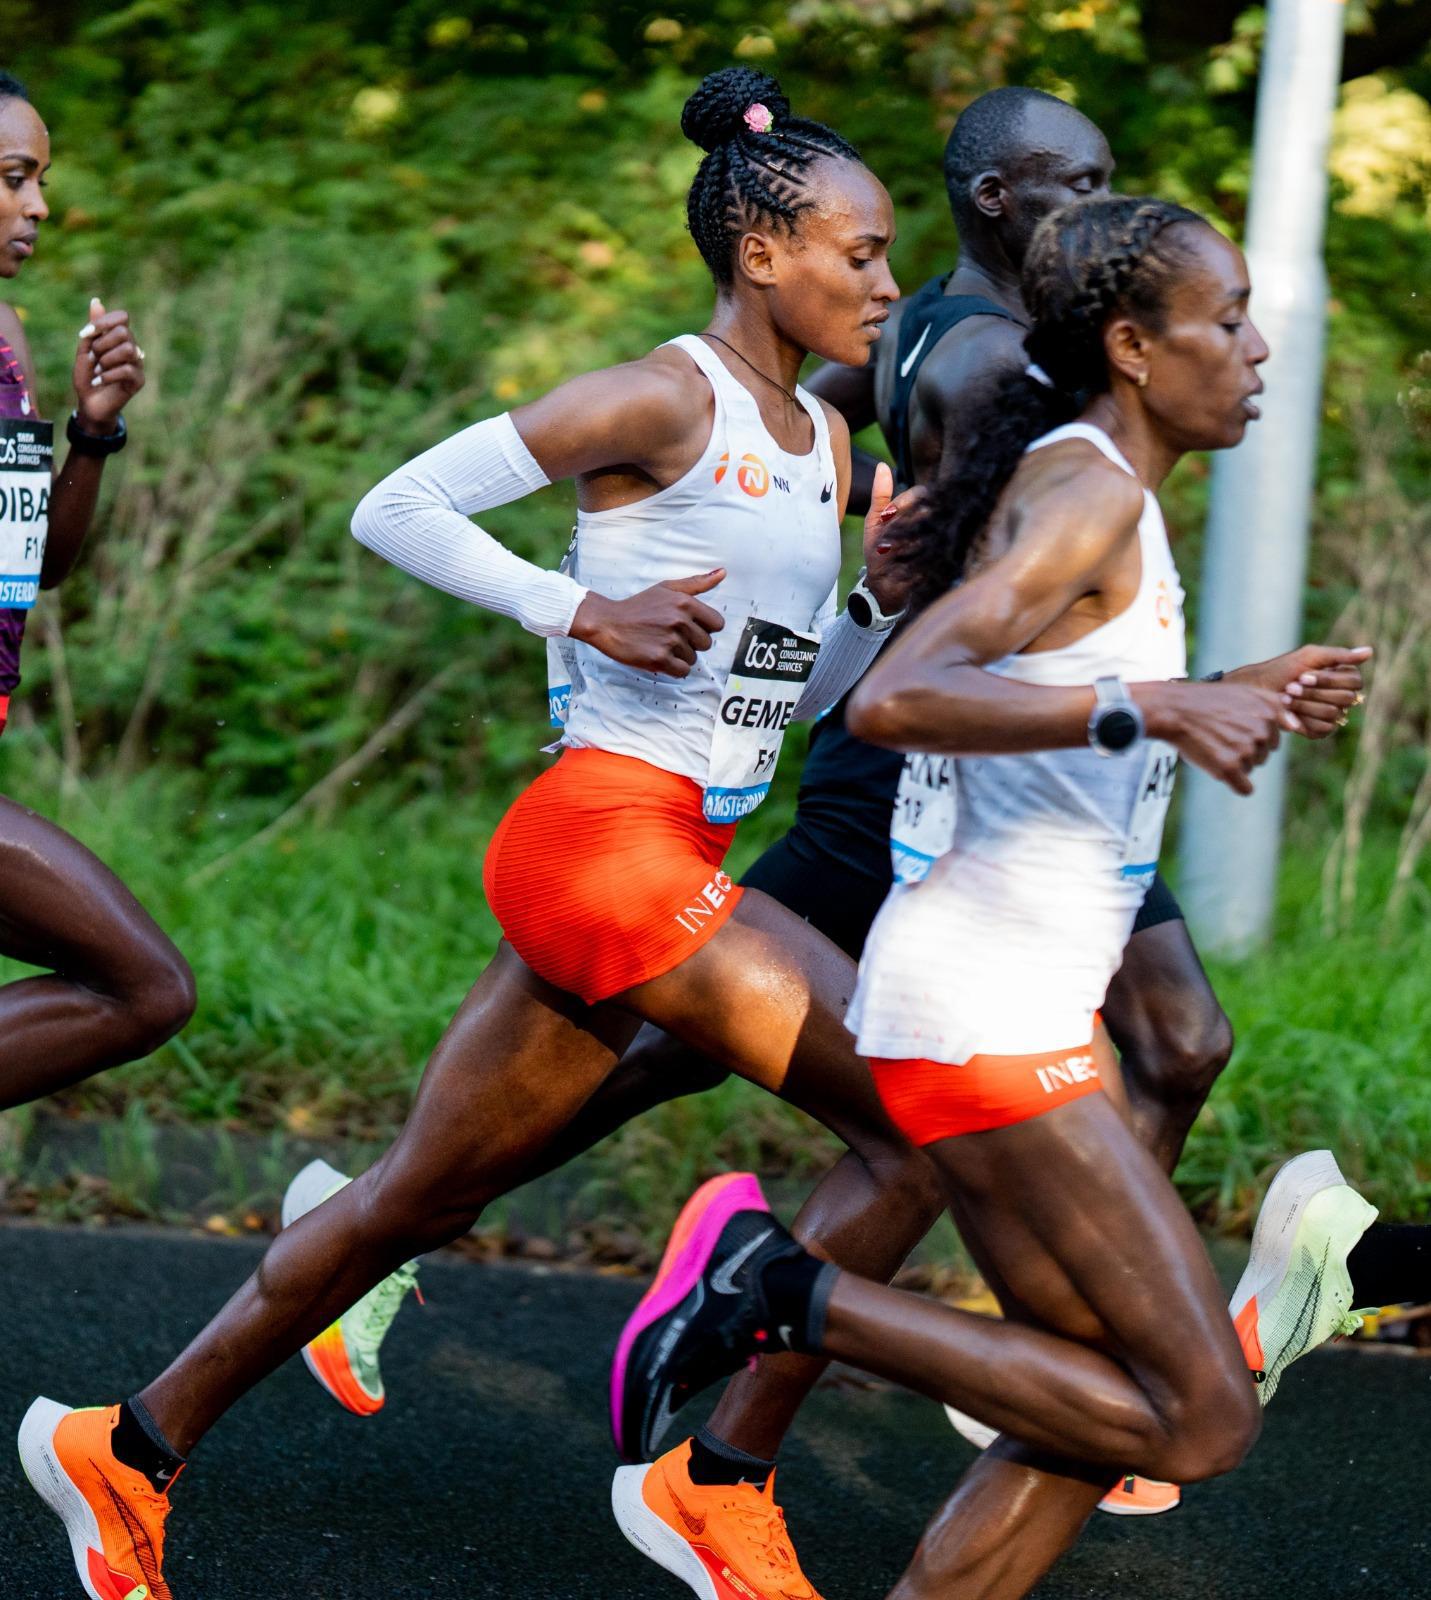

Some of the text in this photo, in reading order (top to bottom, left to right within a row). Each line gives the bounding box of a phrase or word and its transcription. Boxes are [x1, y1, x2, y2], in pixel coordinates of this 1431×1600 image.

[773, 475, 790, 493] NN
[783, 637, 798, 648] TATA
[776, 661, 803, 672] SERVICES
[721, 695, 795, 730] GEME
